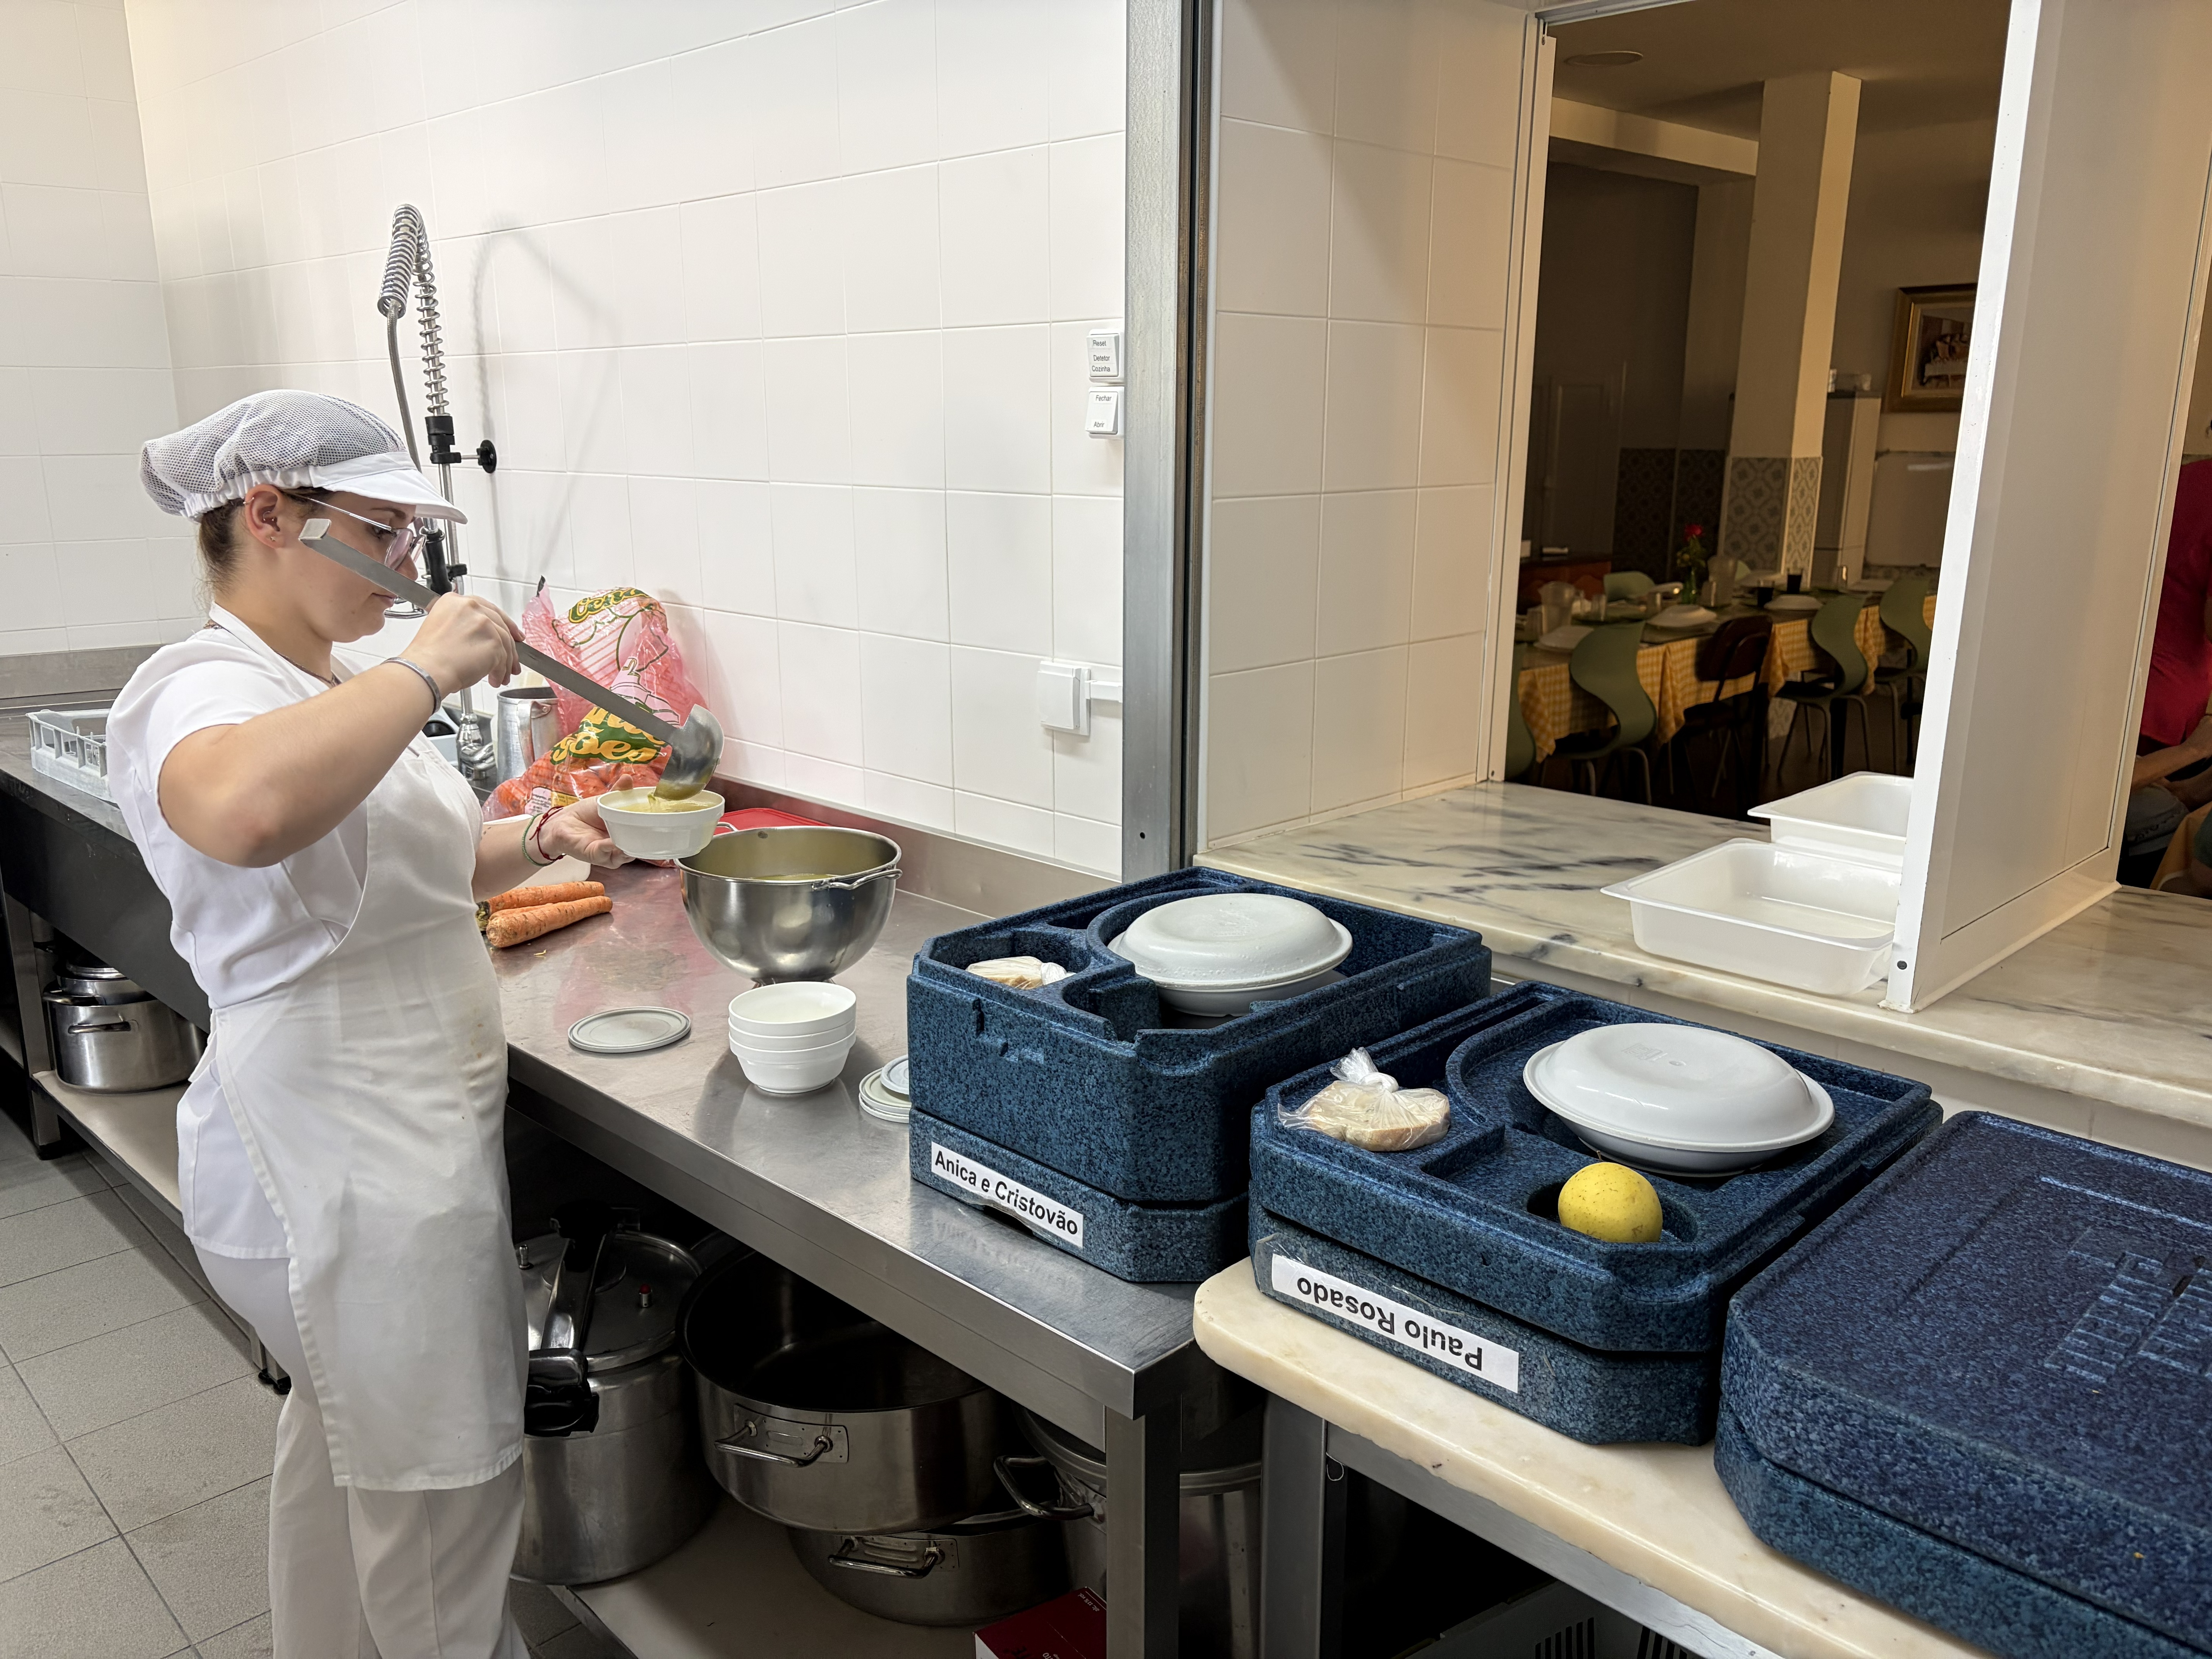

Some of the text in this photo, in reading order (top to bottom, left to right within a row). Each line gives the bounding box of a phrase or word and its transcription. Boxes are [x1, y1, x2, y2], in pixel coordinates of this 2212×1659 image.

[935, 1150, 1078, 1235] Anica e Cristovão
[1297, 1277, 1483, 1371] Paulo Rosado
